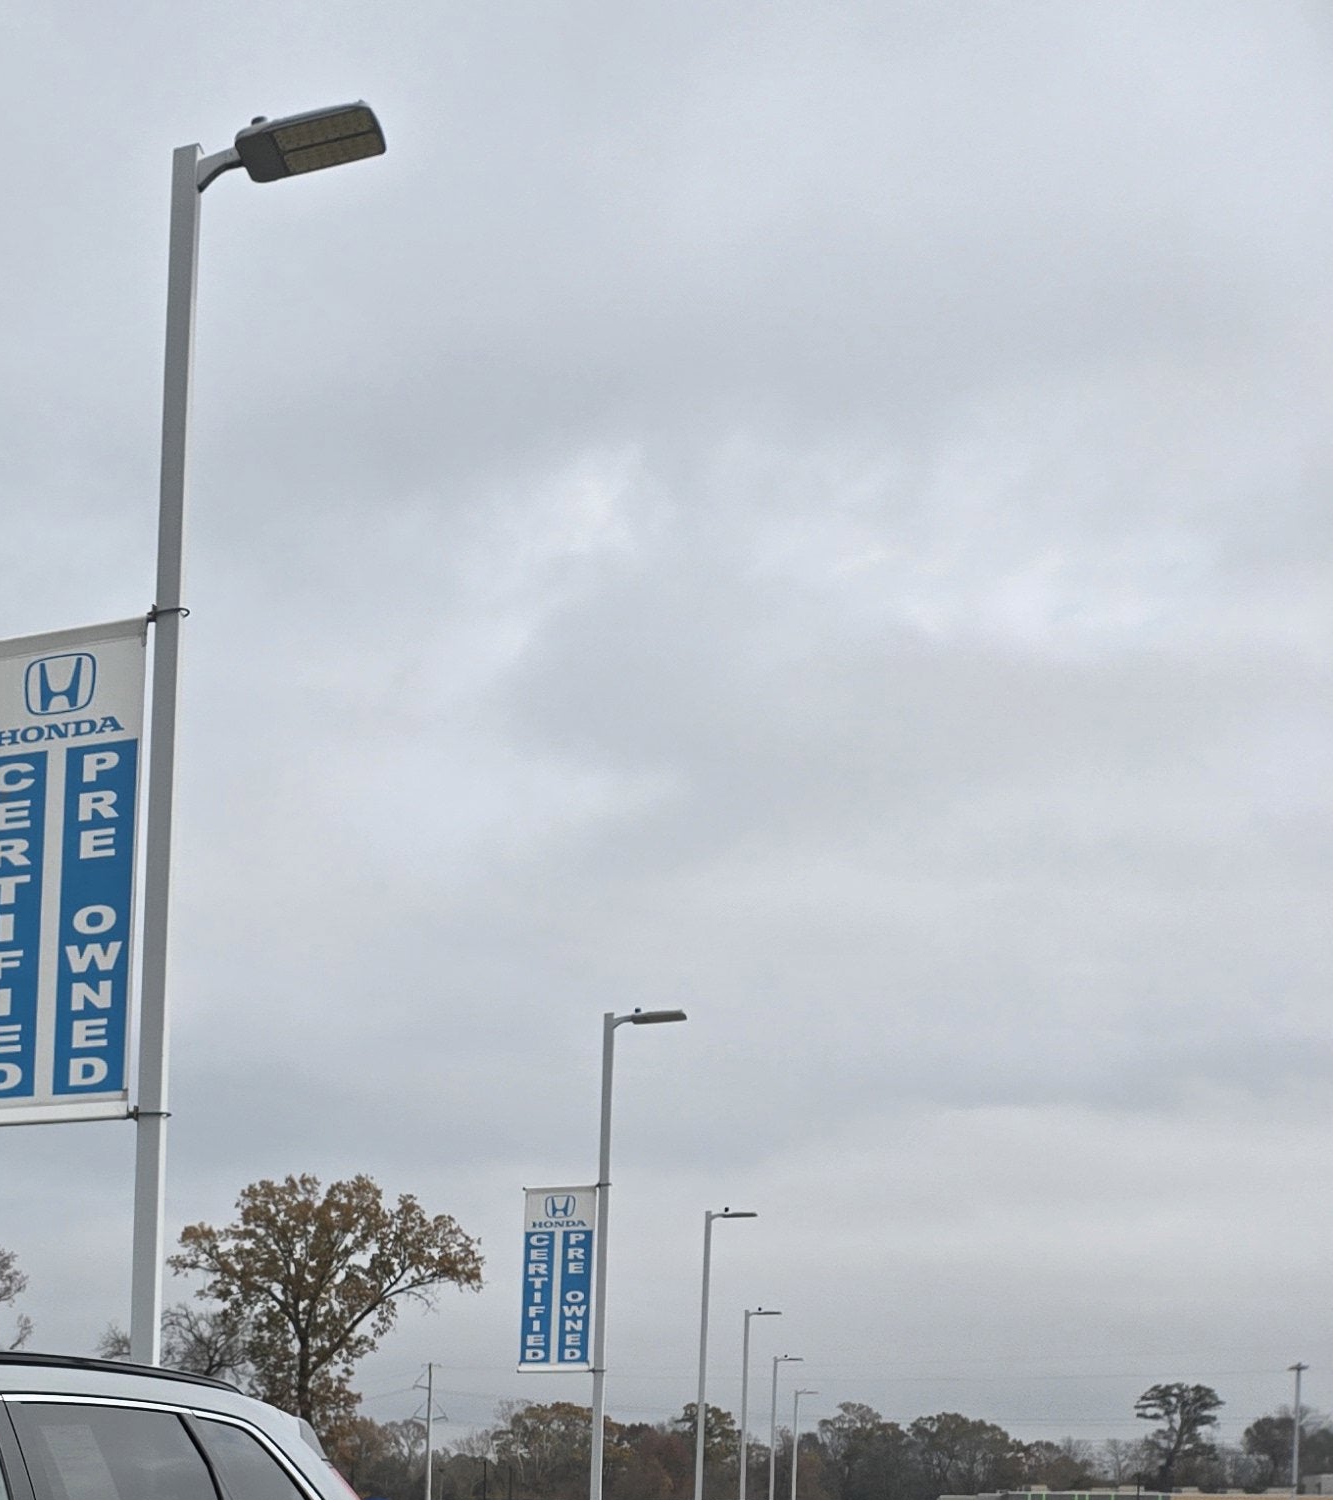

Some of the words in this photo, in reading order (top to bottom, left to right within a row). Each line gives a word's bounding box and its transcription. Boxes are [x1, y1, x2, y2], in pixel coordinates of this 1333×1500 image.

[77, 751, 120, 861] PRE
[64, 904, 123, 1087] OWNED
[531, 1220, 587, 1229] HONDA
[567, 1233, 586, 1275] PRE
[525, 1233, 550, 1362] CERTIFIED
[562, 1290, 587, 1361] OWNED
